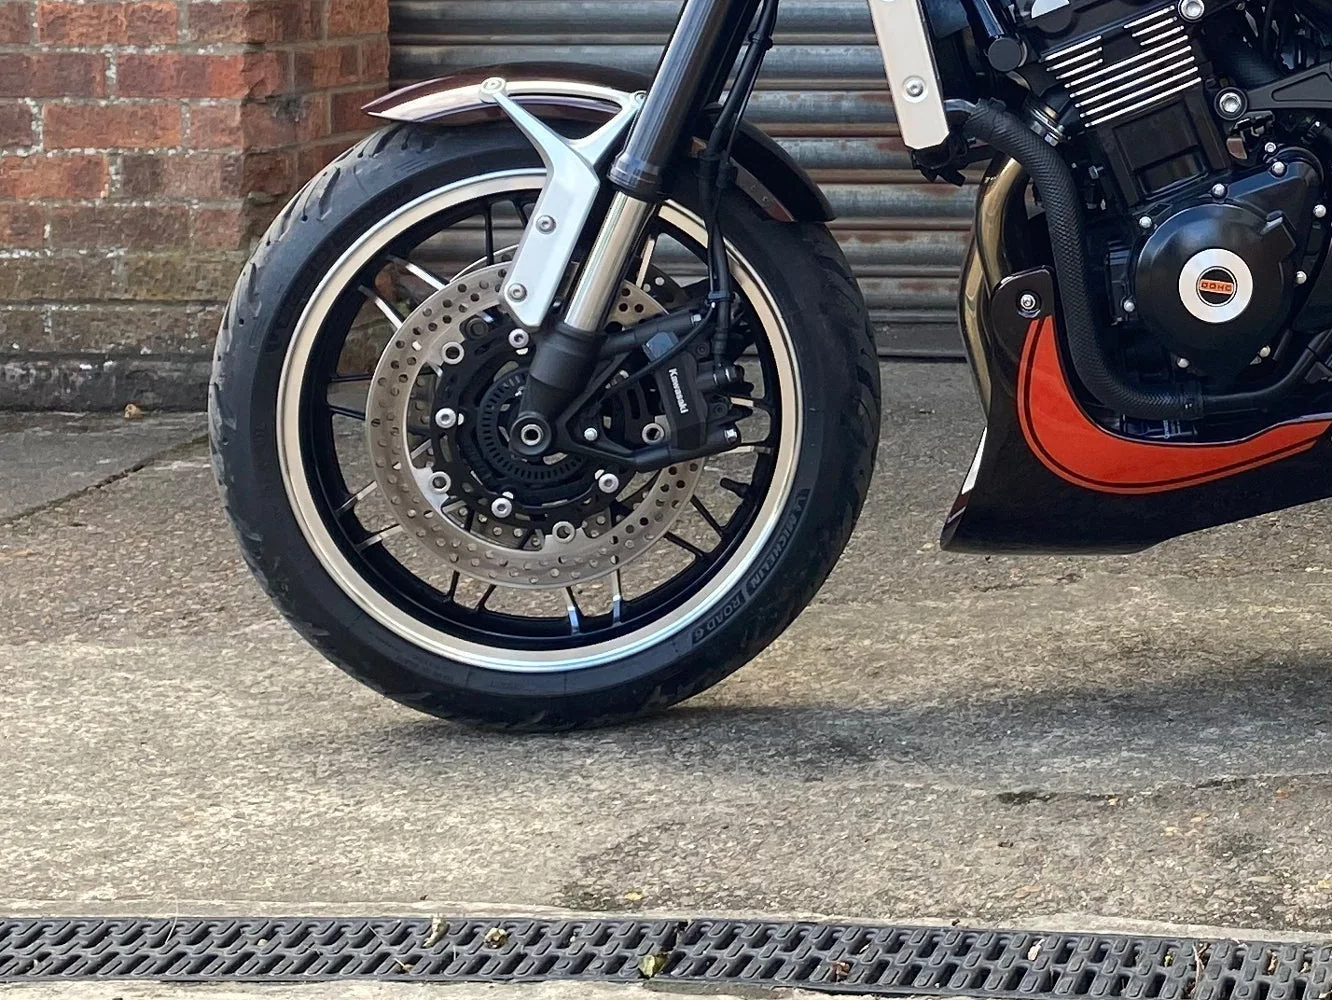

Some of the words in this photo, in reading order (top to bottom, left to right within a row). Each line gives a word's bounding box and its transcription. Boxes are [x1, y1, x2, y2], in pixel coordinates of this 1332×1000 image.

[668, 367, 689, 414] Kawasaki
[749, 513, 798, 589] MICHELIN
[706, 591, 743, 631] ROAD
